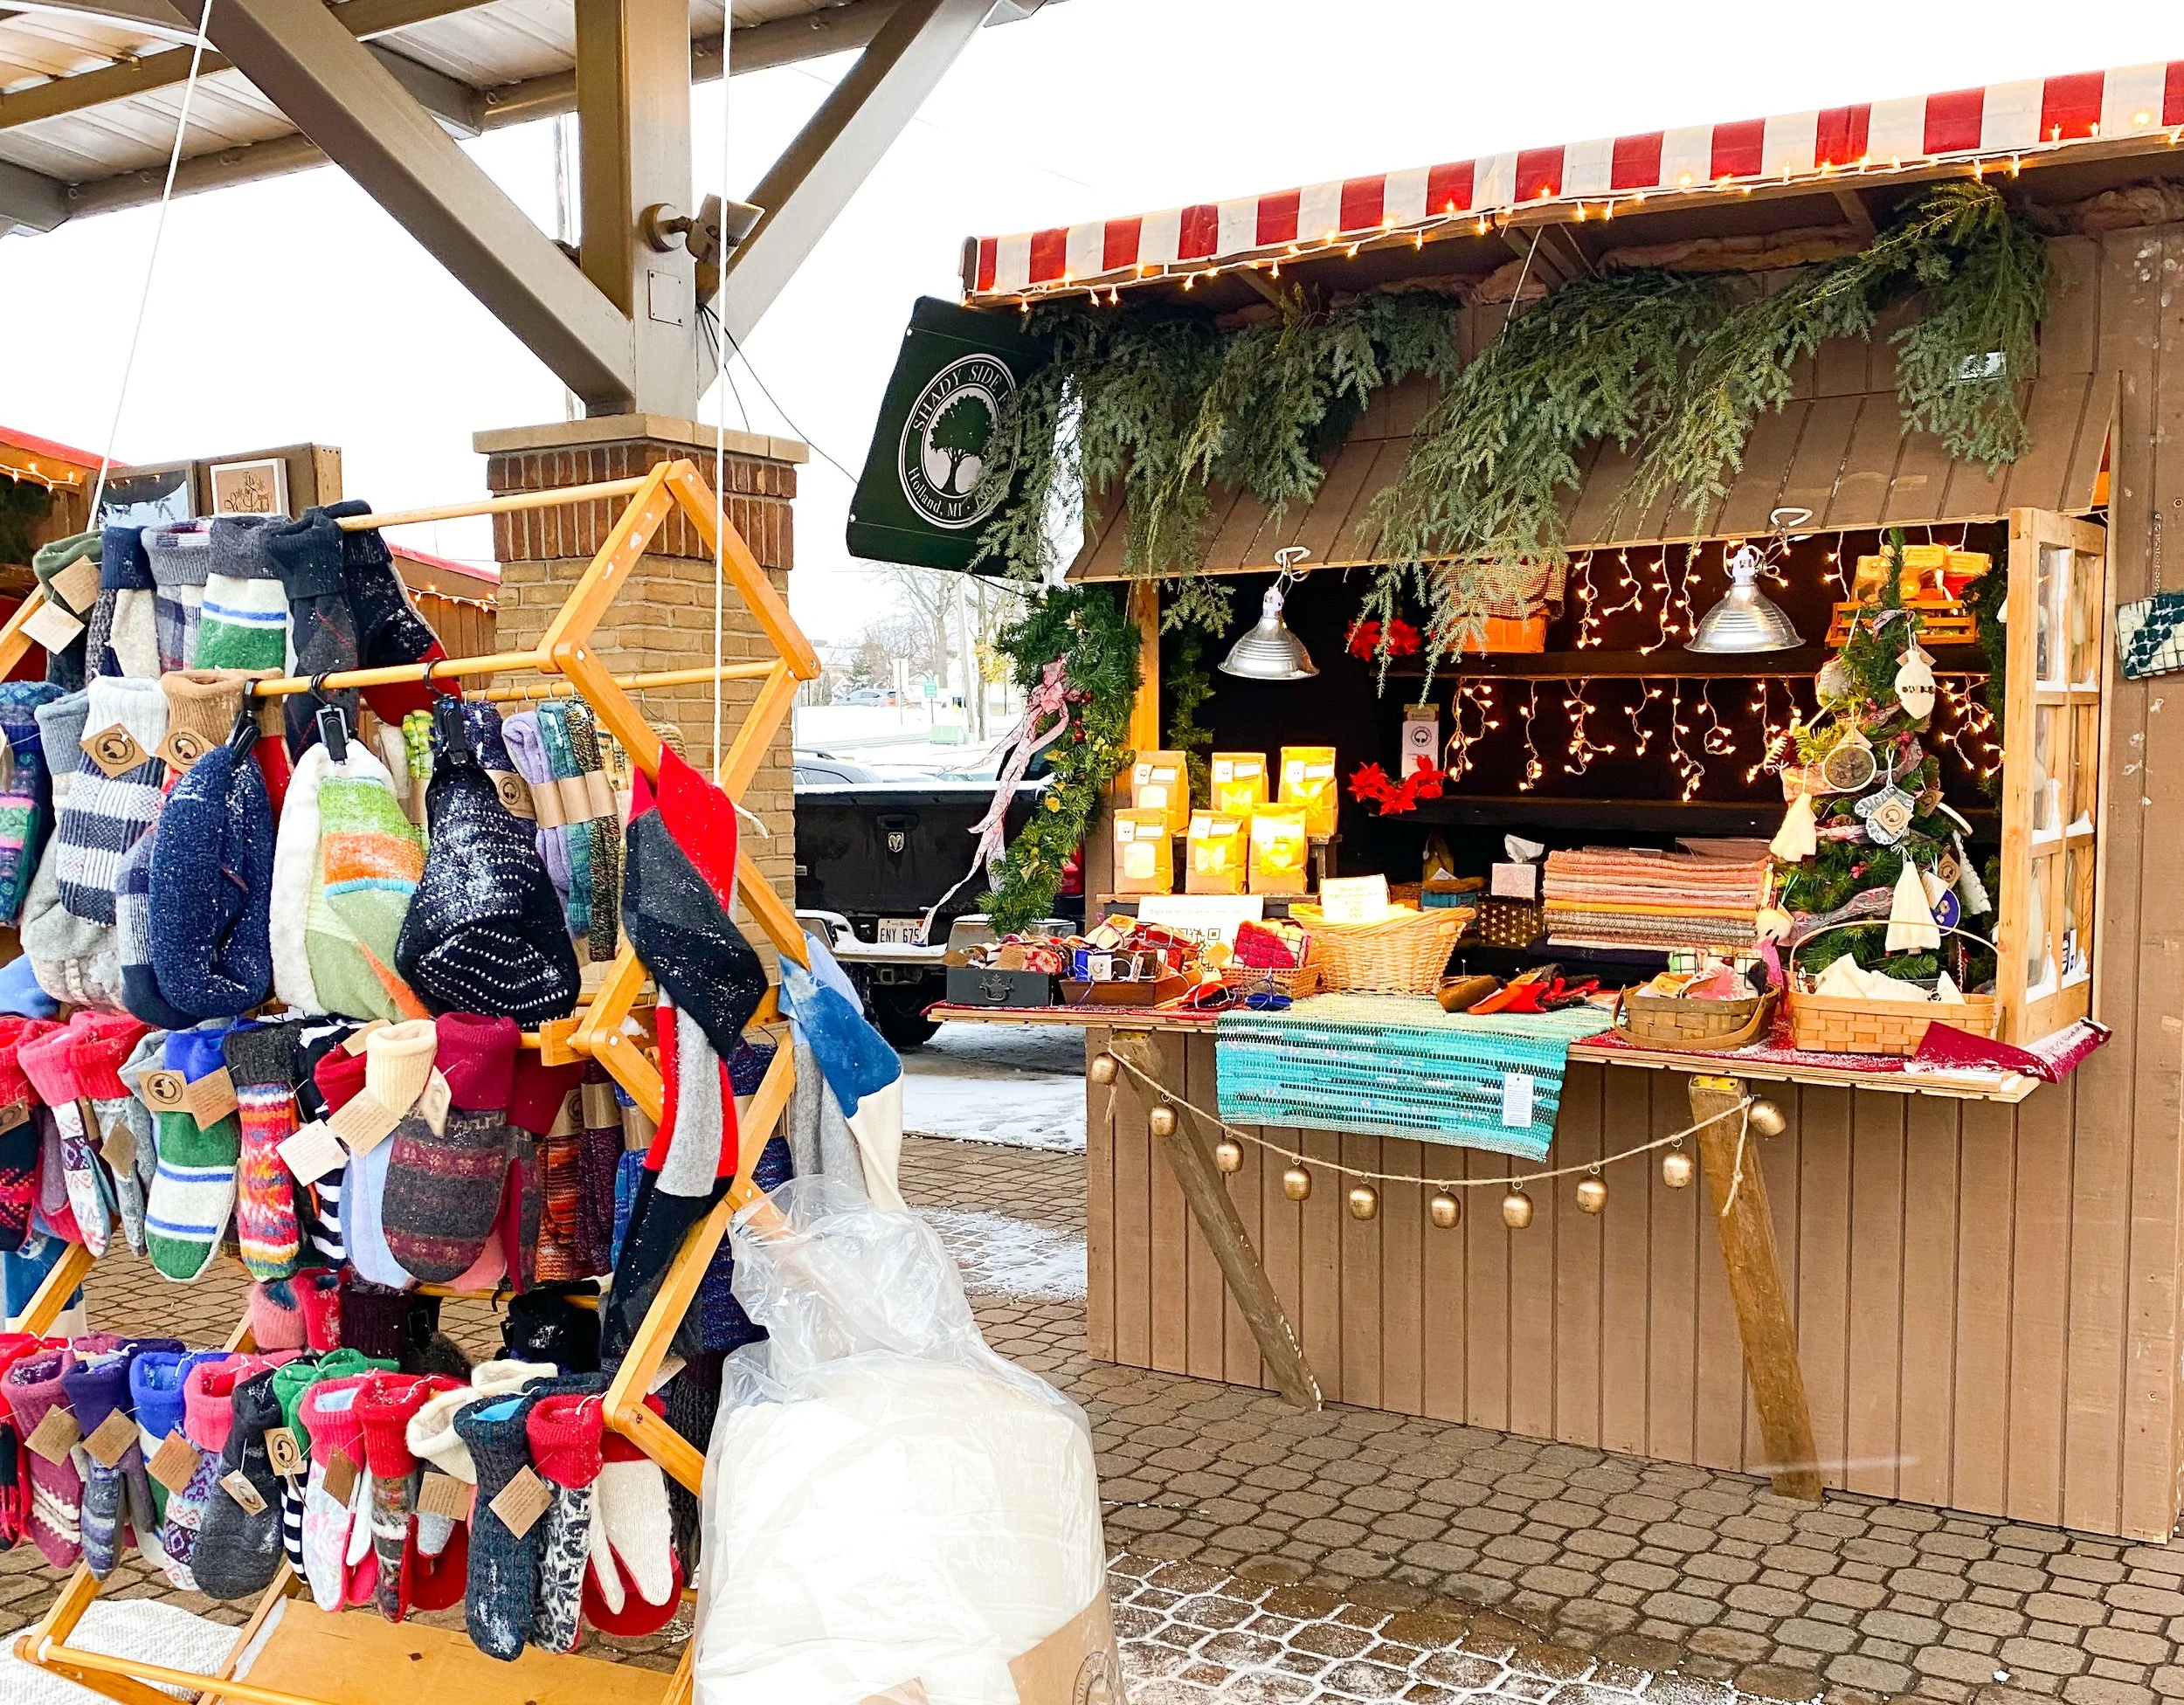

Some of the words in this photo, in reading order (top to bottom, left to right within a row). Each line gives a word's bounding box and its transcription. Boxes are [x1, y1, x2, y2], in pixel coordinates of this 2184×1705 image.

[913, 368, 962, 431] SHADY
[968, 364, 1002, 392] SIDE
[907, 466, 943, 516] Holland,
[947, 502, 963, 517] MI
[881, 928, 896, 942] ENY
[902, 928, 924, 943] 675
